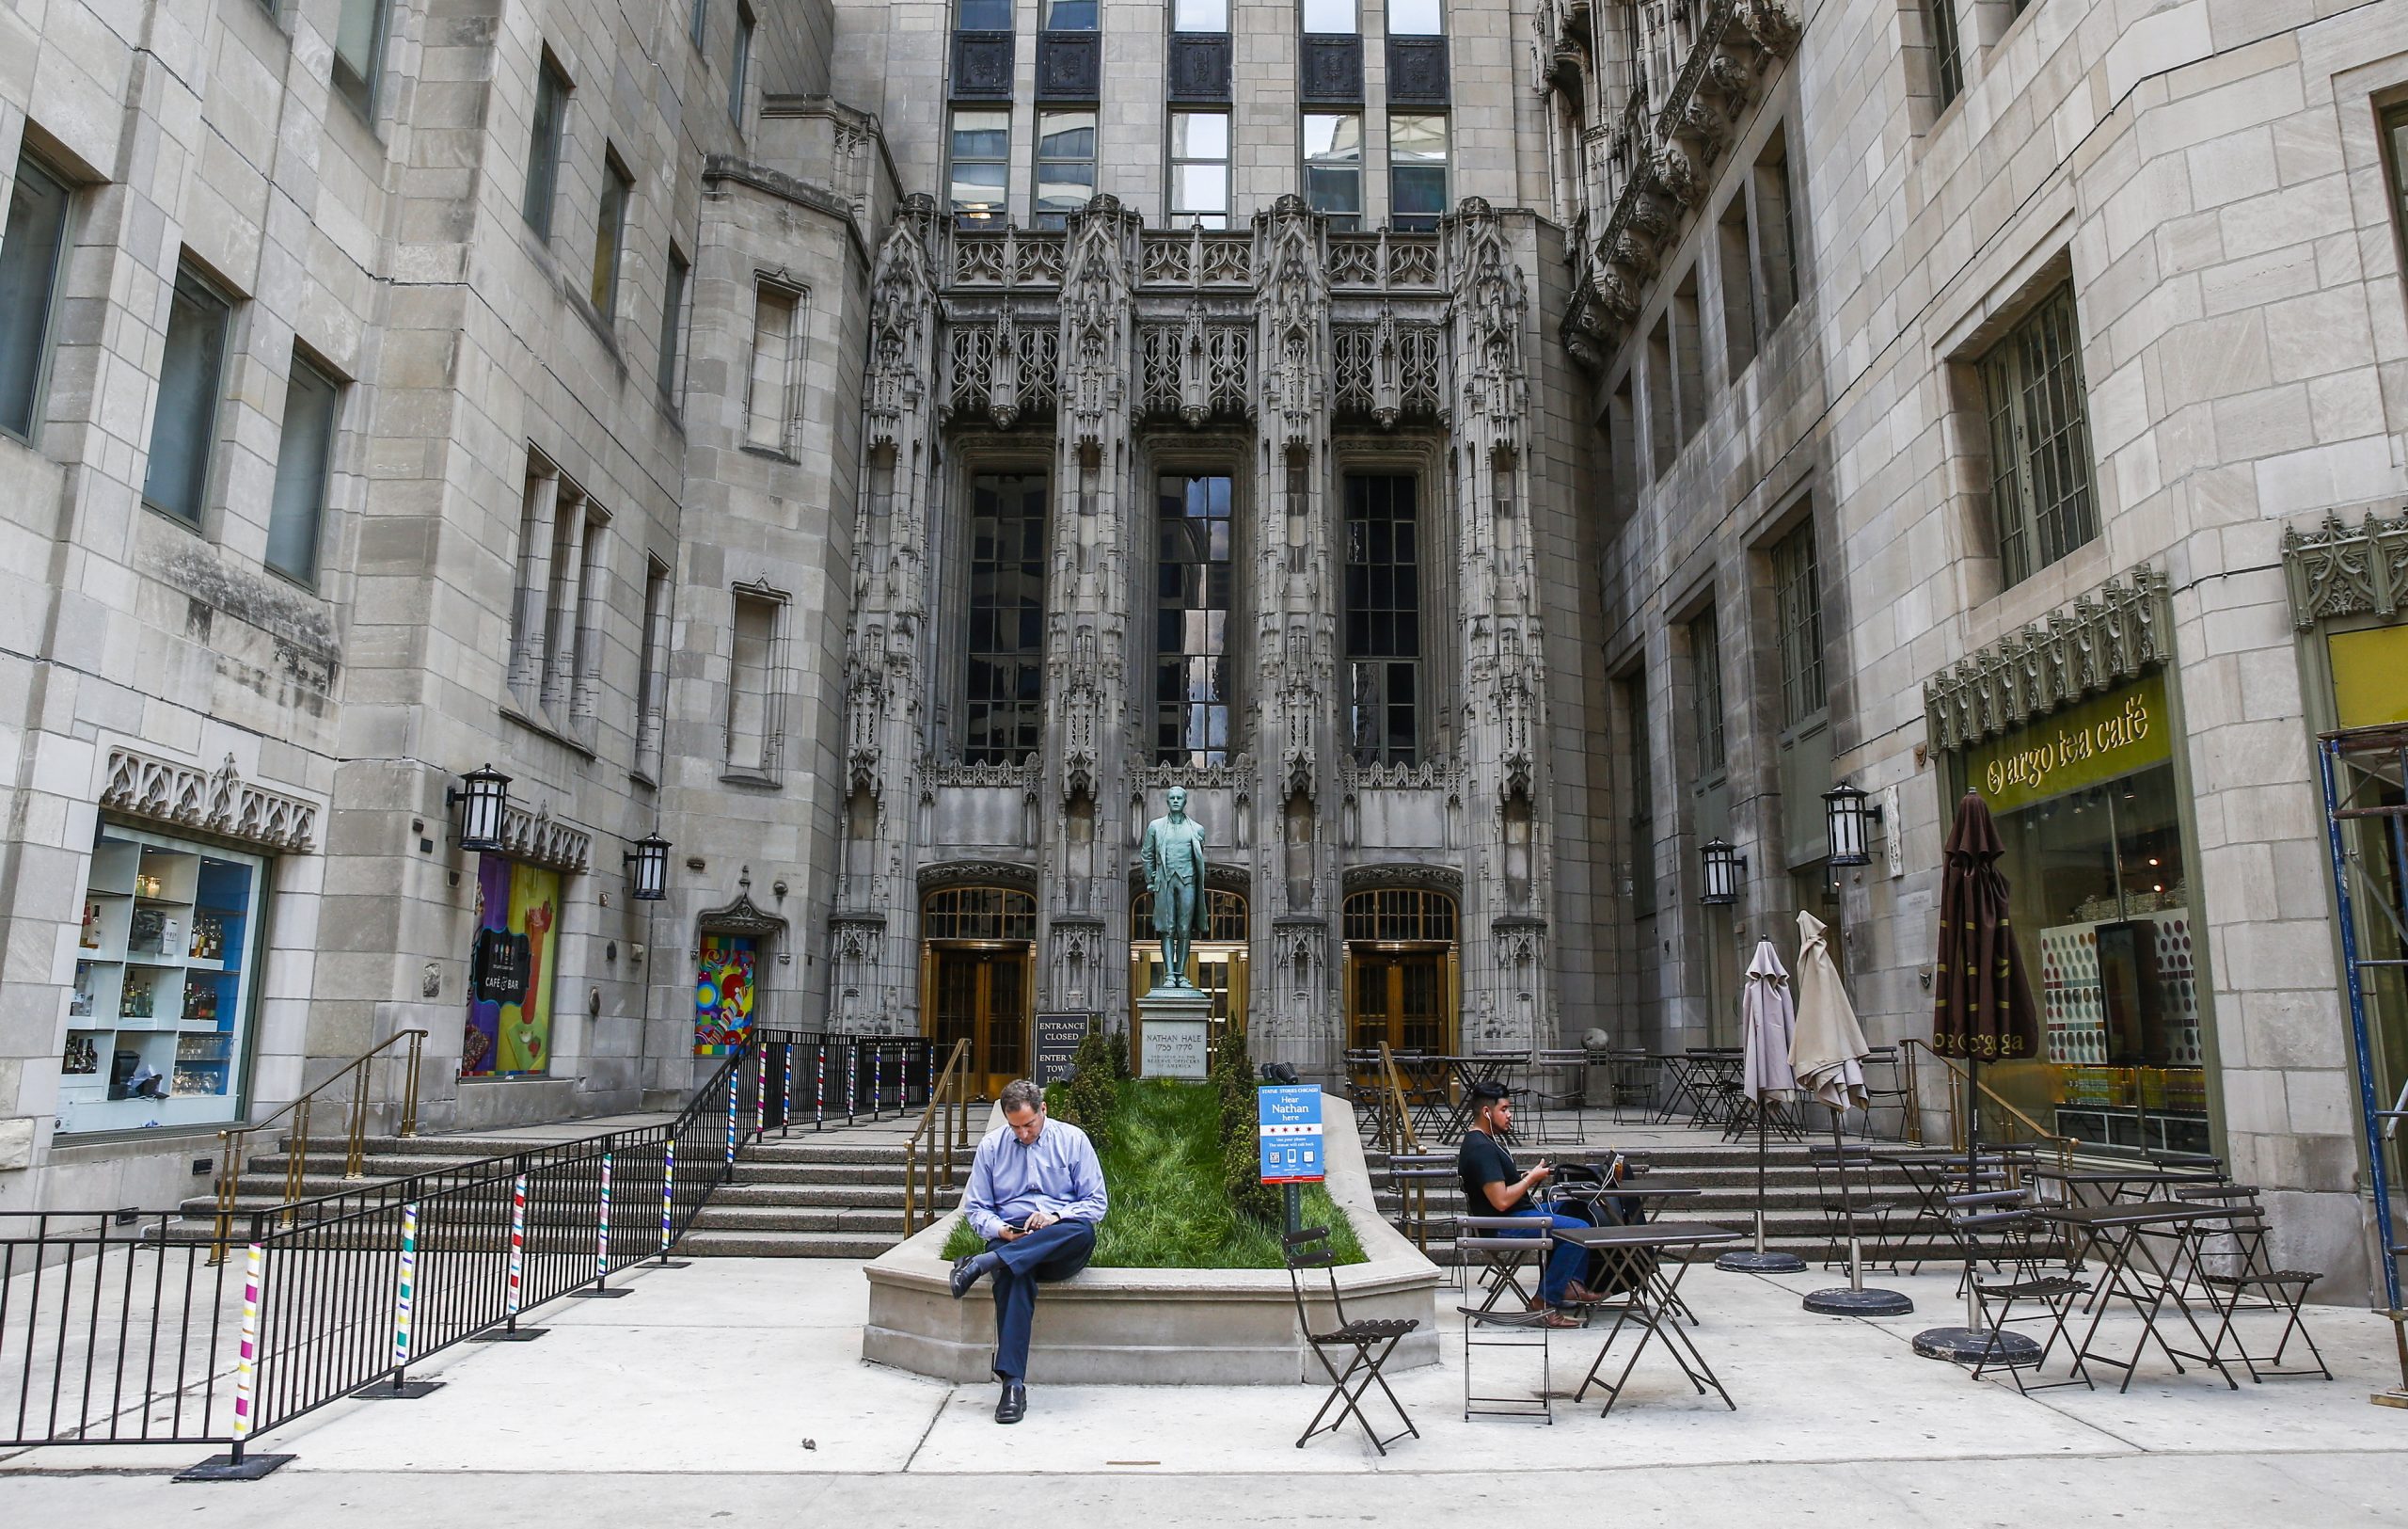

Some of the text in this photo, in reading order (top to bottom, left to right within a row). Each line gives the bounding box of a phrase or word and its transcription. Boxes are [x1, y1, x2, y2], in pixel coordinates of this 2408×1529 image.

[2006, 693, 2148, 788] argo tea café
[484, 976, 500, 987] CAFÉ
[508, 980, 519, 990] BAR
[1176, 1043, 1194, 1052] 1776
[1272, 1104, 1309, 1114] Nathan
